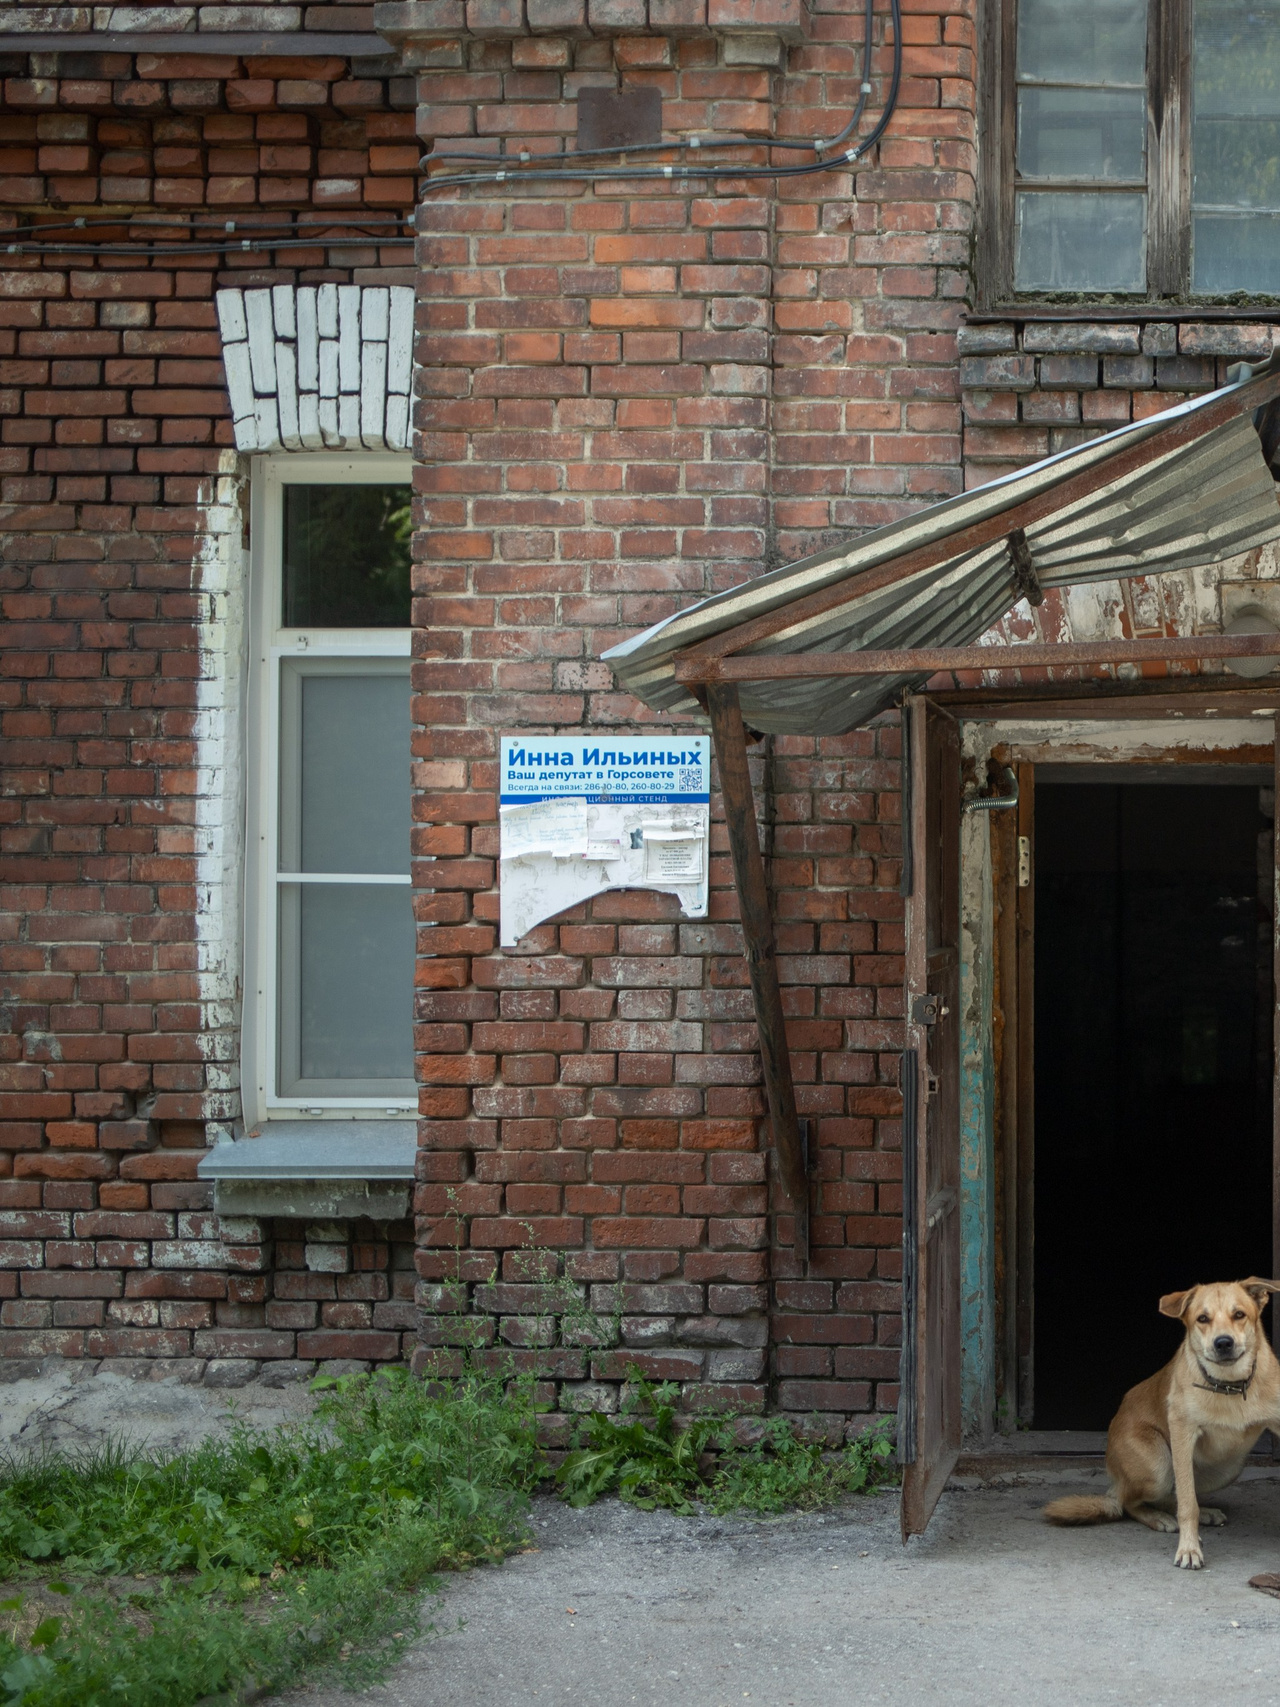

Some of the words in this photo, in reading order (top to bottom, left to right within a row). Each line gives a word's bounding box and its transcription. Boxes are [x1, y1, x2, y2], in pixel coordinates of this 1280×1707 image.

[508, 748, 574, 767] Инна
[582, 748, 702, 766] Ильиных
[508, 770, 535, 780] Ваш
[539, 771, 593, 782] депутат
[596, 771, 604, 779] в
[607, 769, 674, 781] Горсовете
[508, 783, 539, 792] Всегда
[630, 782, 675, 791] 260-80-29
[638, 795, 668, 803] СТЕНД
